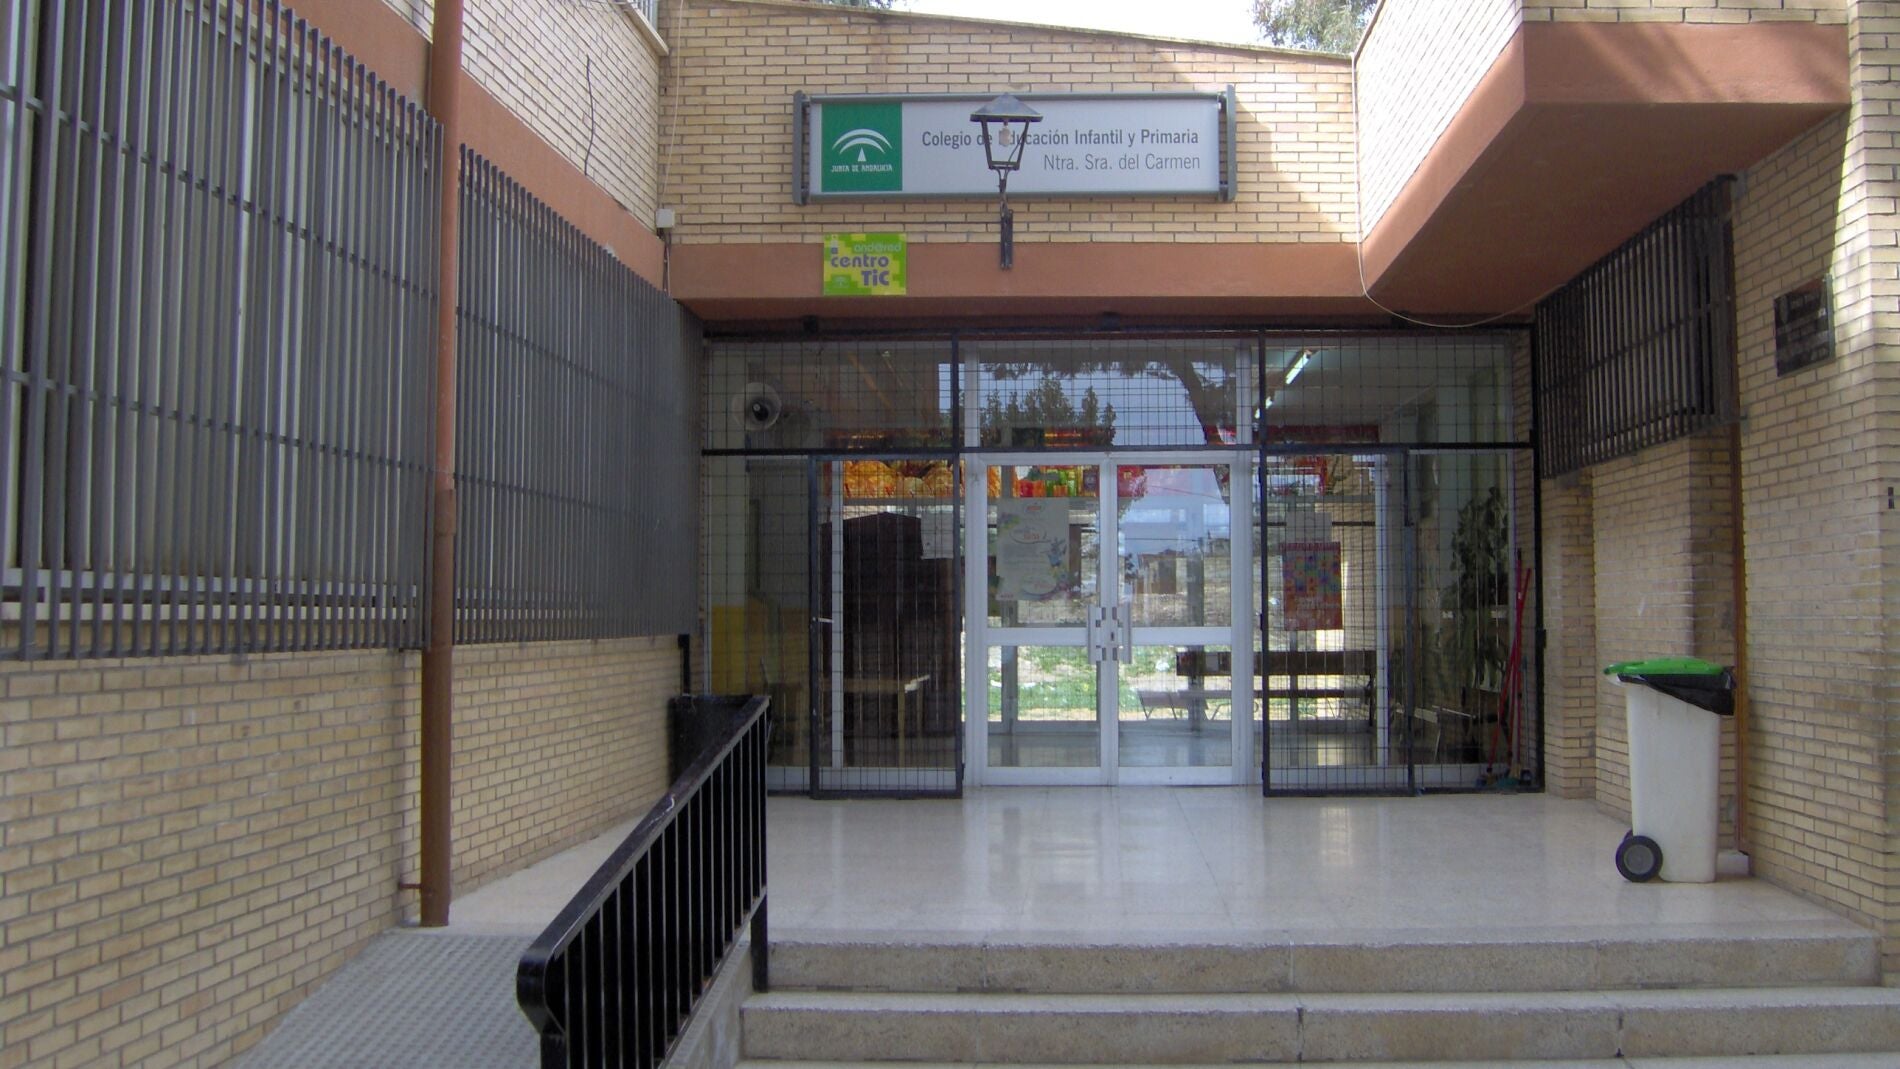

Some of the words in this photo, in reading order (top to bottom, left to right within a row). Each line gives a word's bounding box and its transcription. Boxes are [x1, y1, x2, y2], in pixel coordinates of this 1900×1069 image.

[922, 131, 972, 149] Colegio
[1075, 129, 1123, 145] Infantil
[1127, 132, 1136, 148] y
[1141, 128, 1199, 144] Primaria
[831, 165, 850, 173] JUNTA
[851, 164, 859, 172] DE
[1043, 154, 1079, 171] Ntra.
[1085, 153, 1113, 170] Sra.
[1118, 153, 1140, 170] del
[1145, 153, 1200, 170] Carmen
[830, 253, 890, 268] centro
